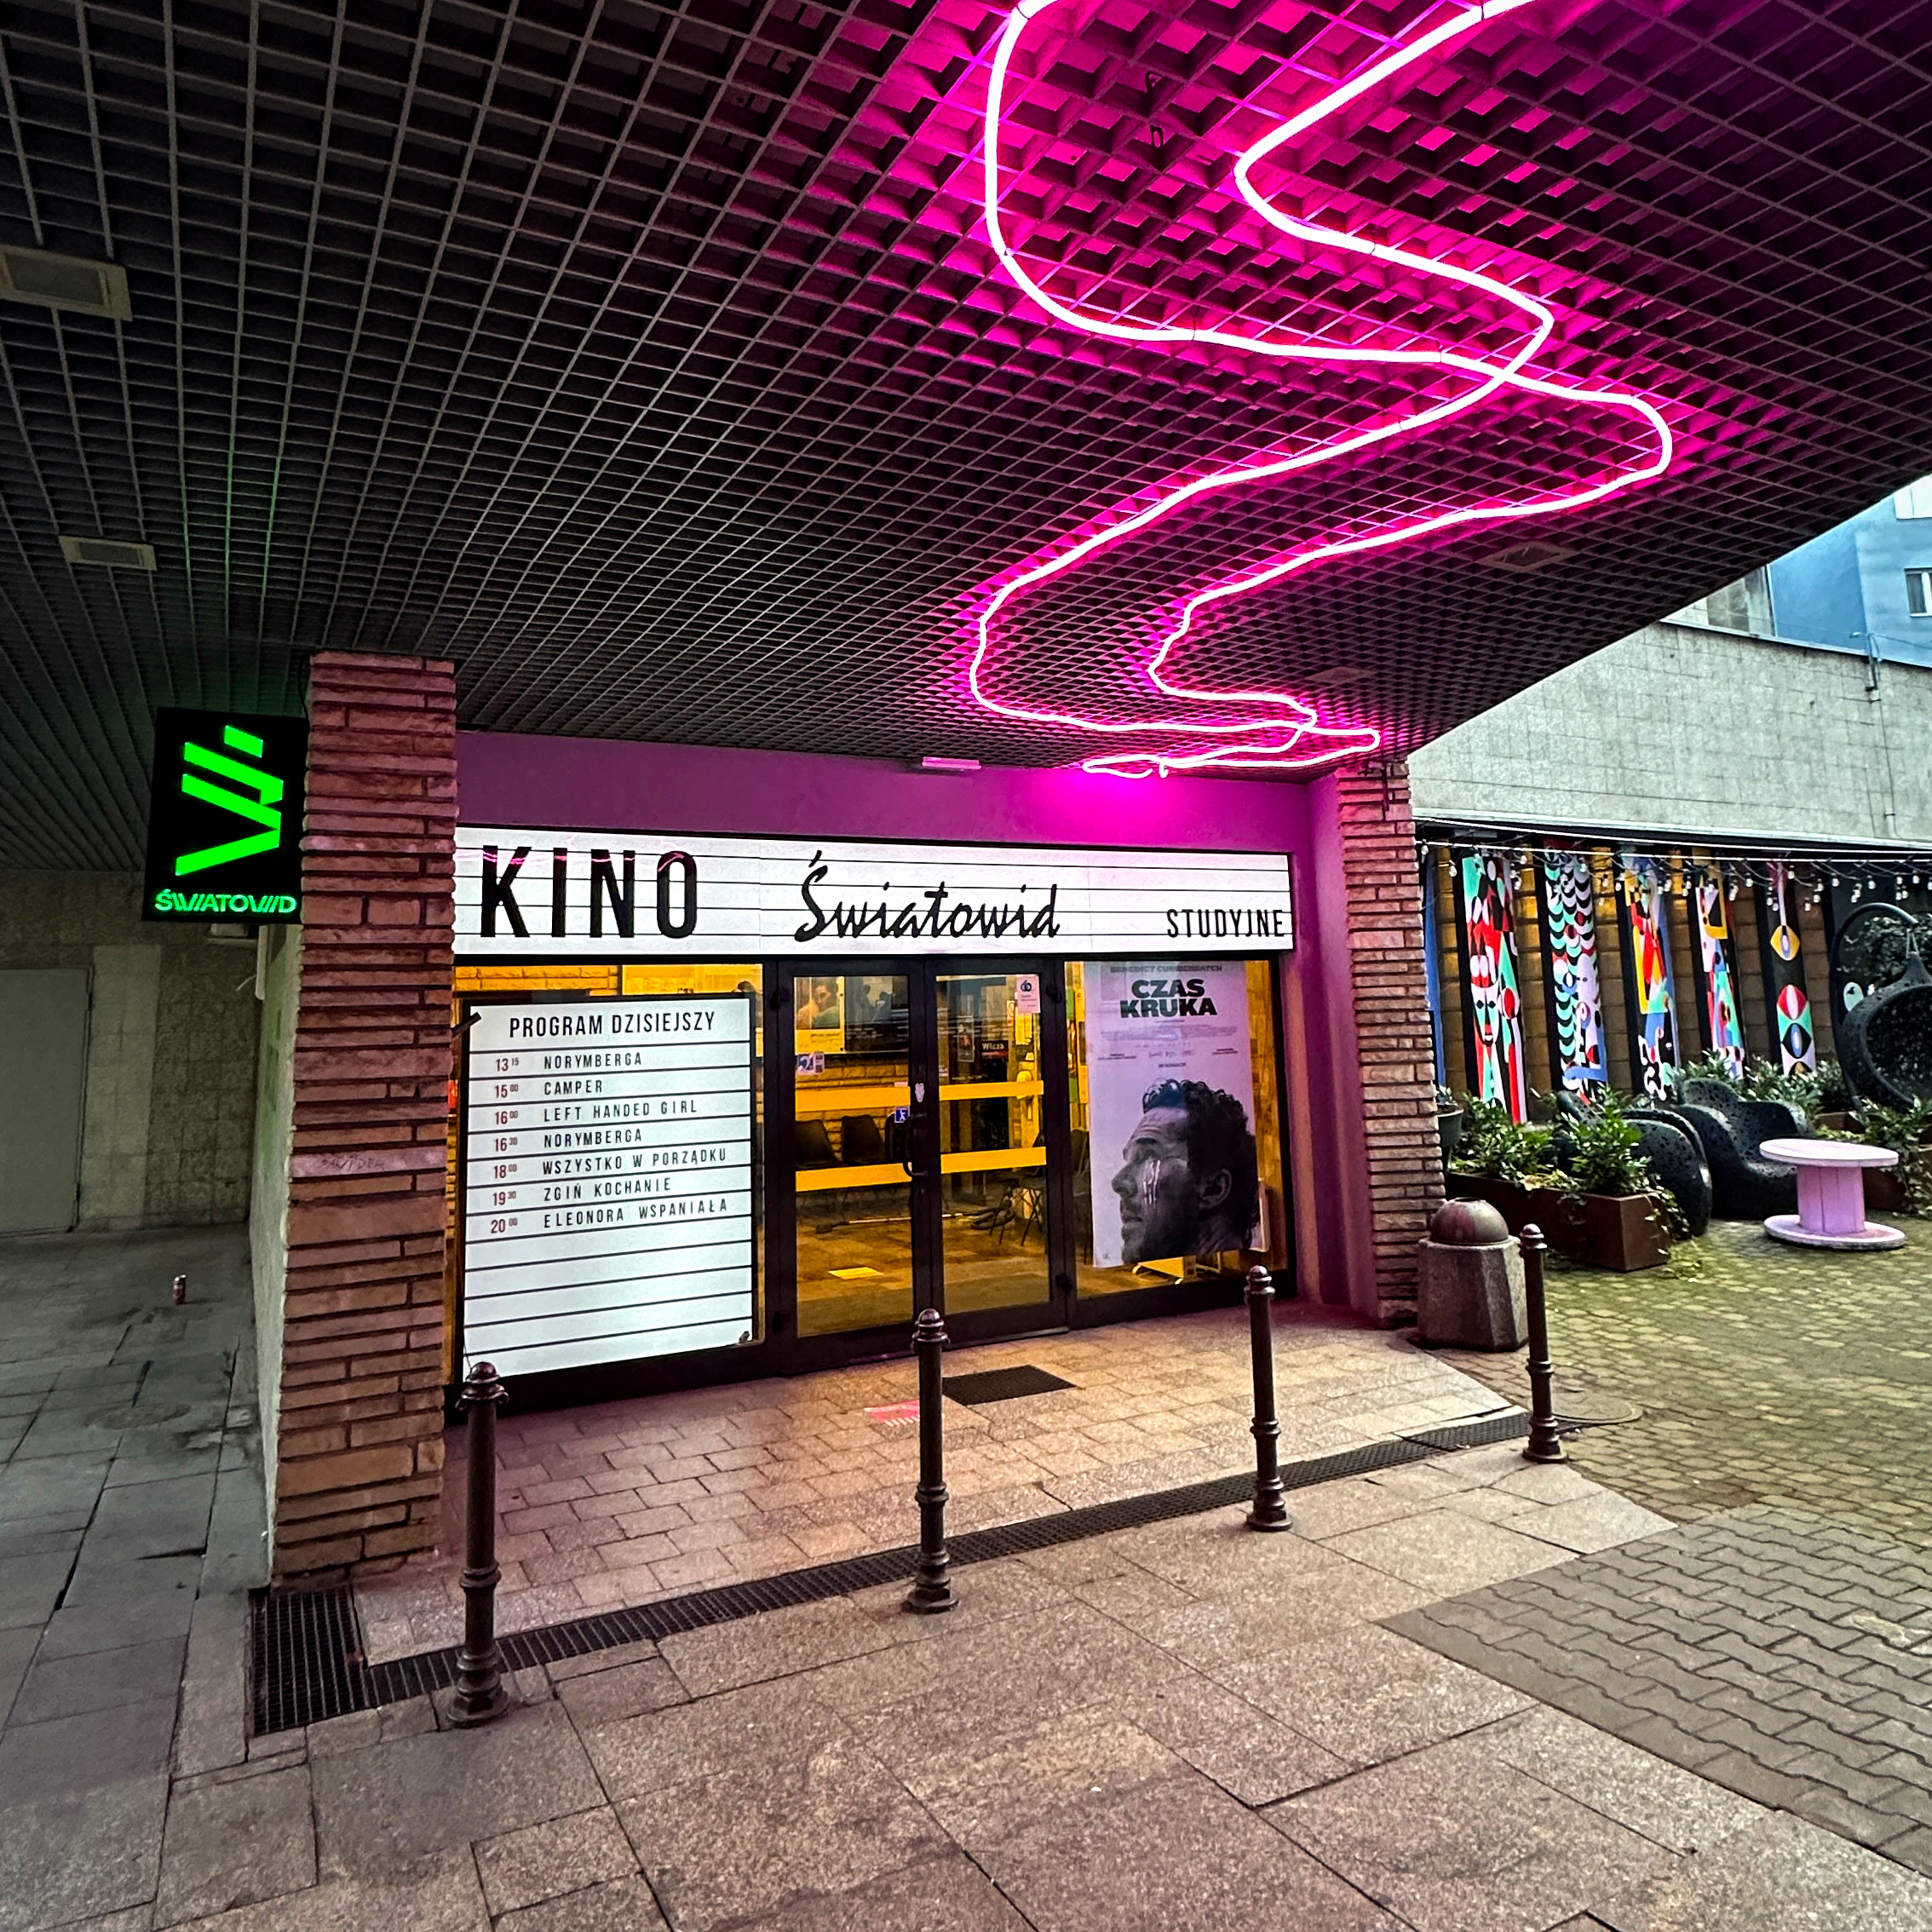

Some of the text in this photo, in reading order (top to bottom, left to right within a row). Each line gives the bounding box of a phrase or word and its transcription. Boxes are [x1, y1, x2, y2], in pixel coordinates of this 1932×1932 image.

[480, 845, 1285, 942] KINO Światowid STUDYJNE
[1131, 979, 1205, 998] CZAS
[1119, 998, 1218, 1019] KRUKA
[509, 1011, 716, 1038] PROGRAM DZISIEJSZY
[543, 1052, 641, 1070] NORYMBERGA
[543, 1079, 603, 1095] CAMPER
[543, 1107, 582, 1123] LEFT
[593, 1102, 650, 1118] HANDED
[660, 1100, 698, 1115] GIRL
[543, 1128, 641, 1148] NORYMBERGA
[542, 1155, 622, 1176] WSZYSTKO
[632, 1153, 643, 1169] W
[653, 1148, 727, 1166] PORZĄDKU
[543, 1182, 582, 1202] ZGIŃ
[594, 1177, 671, 1198] KOCHANIE
[543, 1207, 624, 1228] ELEONORA
[638, 1199, 727, 1220] WSPANIAŁA
